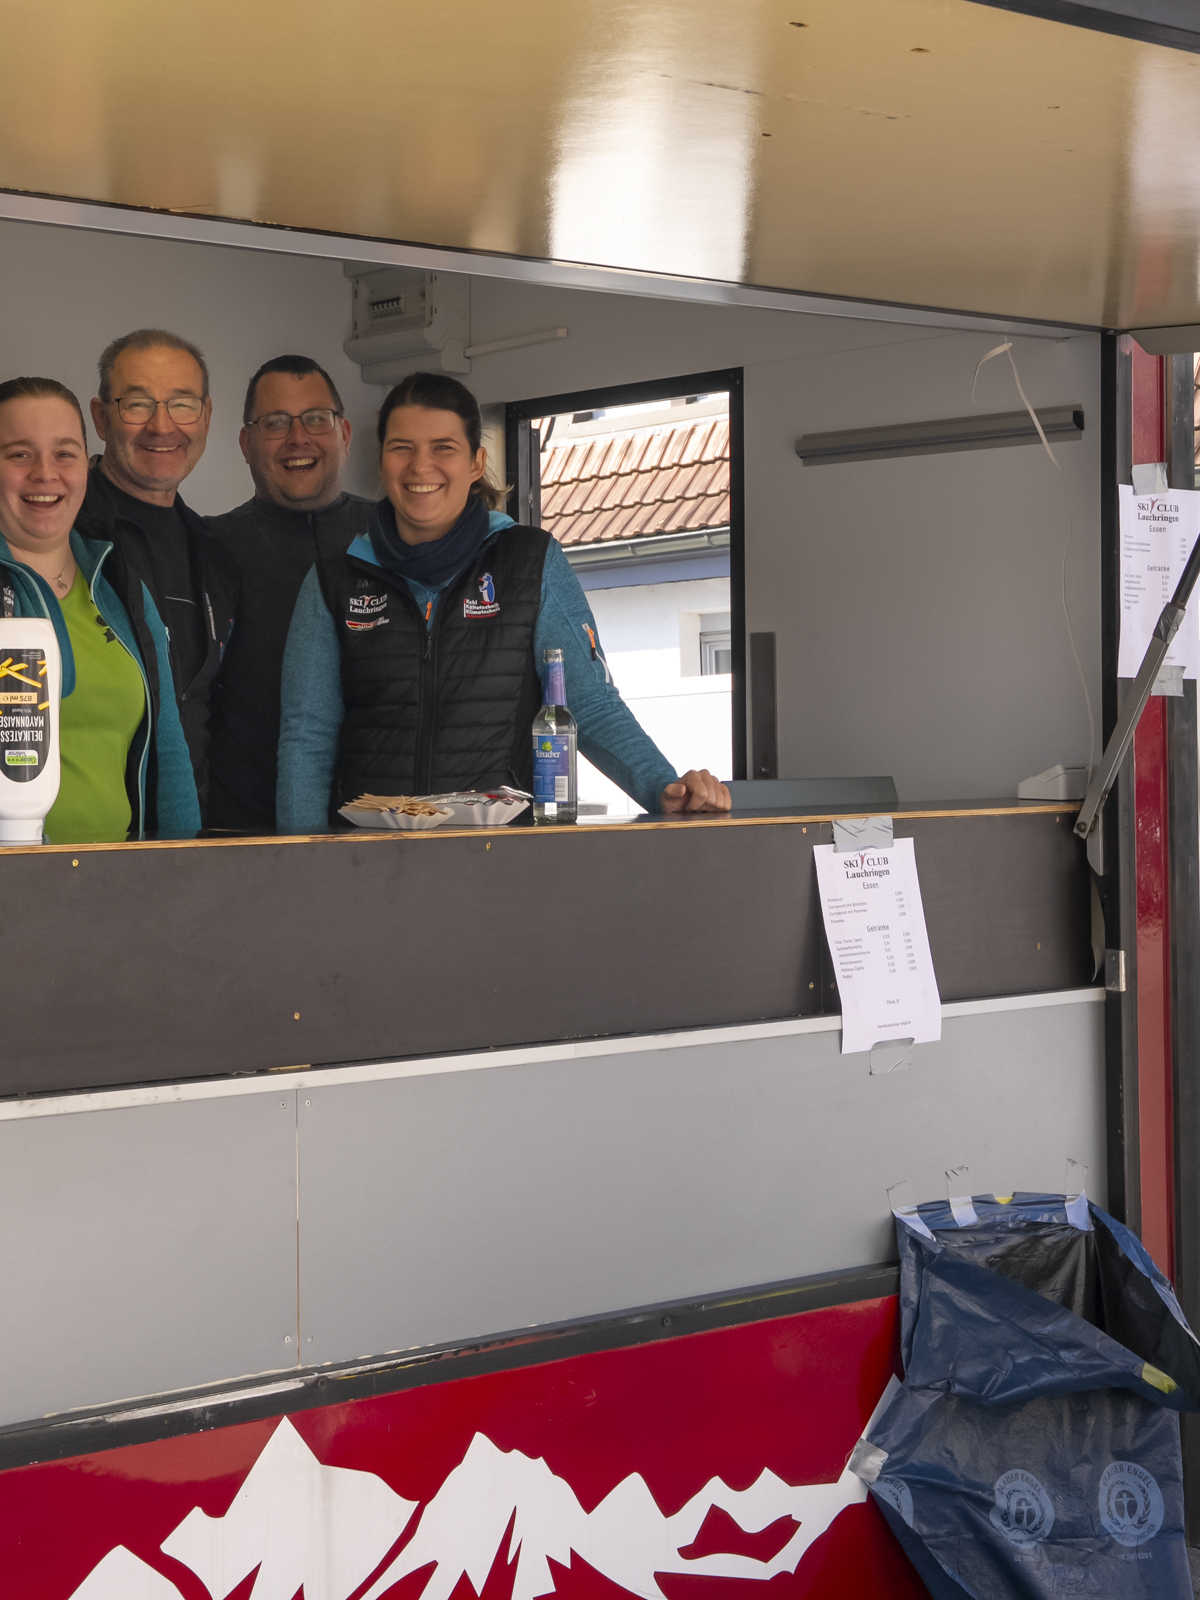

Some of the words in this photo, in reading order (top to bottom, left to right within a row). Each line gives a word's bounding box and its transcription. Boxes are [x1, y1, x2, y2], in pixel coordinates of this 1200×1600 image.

[1138, 503, 1149, 511] SKI
[1157, 504, 1179, 512] CLUB
[1138, 513, 1179, 523] Lauchringen
[1149, 525, 1167, 533] Essen
[350, 598, 363, 606] SKI
[0, 716, 44, 728] MAYONNAISE
[0, 730, 43, 742] DELIKATESS
[844, 860, 859, 869] SKI
[866, 856, 889, 867] CLUB
[846, 868, 890, 879] Lauchringen
[862, 882, 880, 890] Essen
[866, 924, 889, 932] Getränke
[1102, 1464, 1124, 1487] BLAUER
[1127, 1465, 1152, 1488] ENGEL
[884, 1478, 906, 1495] ENGEL
[997, 1472, 1019, 1494] BLAUER
[1021, 1473, 1042, 1495] ENGEL
